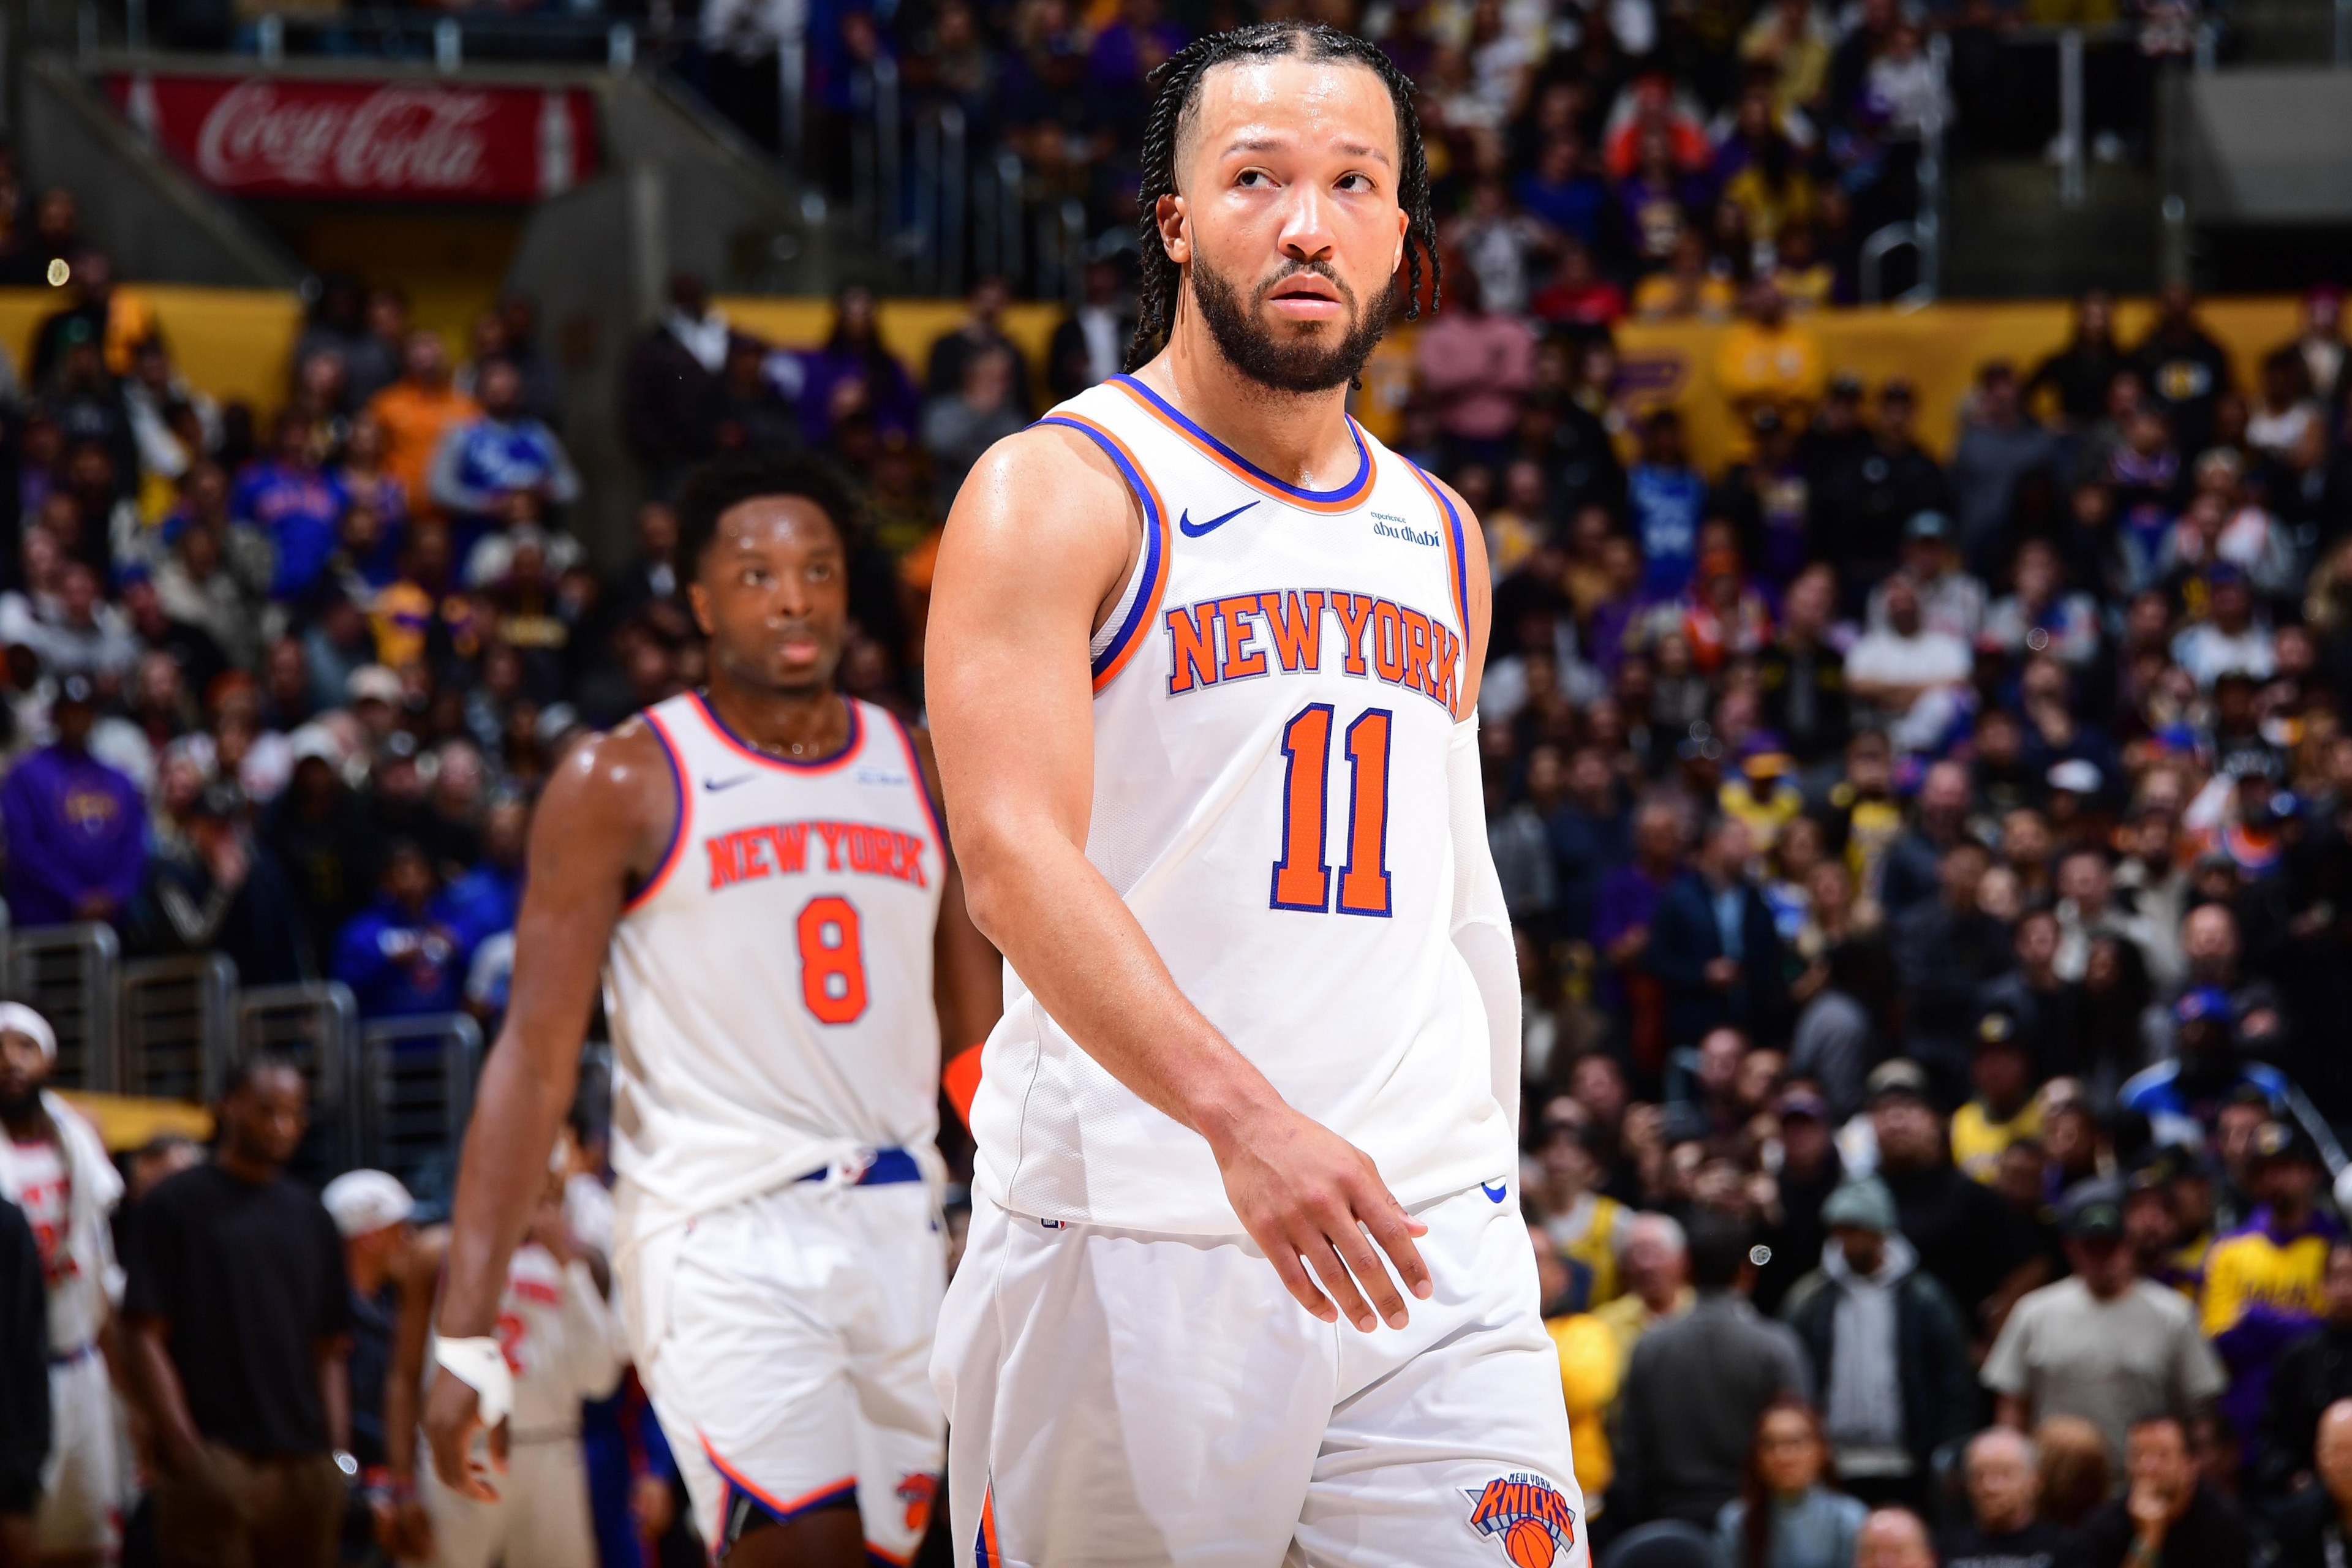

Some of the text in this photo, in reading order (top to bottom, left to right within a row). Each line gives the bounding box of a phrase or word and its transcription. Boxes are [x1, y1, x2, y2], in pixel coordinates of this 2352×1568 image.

[1371, 511, 1406, 523] experience
[1373, 521, 1440, 547] abu dhabi
[1163, 588, 1461, 725] NEW YORK
[1270, 702, 1392, 918] 11
[705, 821, 928, 891] NEW YORK
[796, 895, 869, 1025] 8
[1471, 1477, 1575, 1547] KNICKS
[1509, 1472, 1551, 1491] NEW YORK
